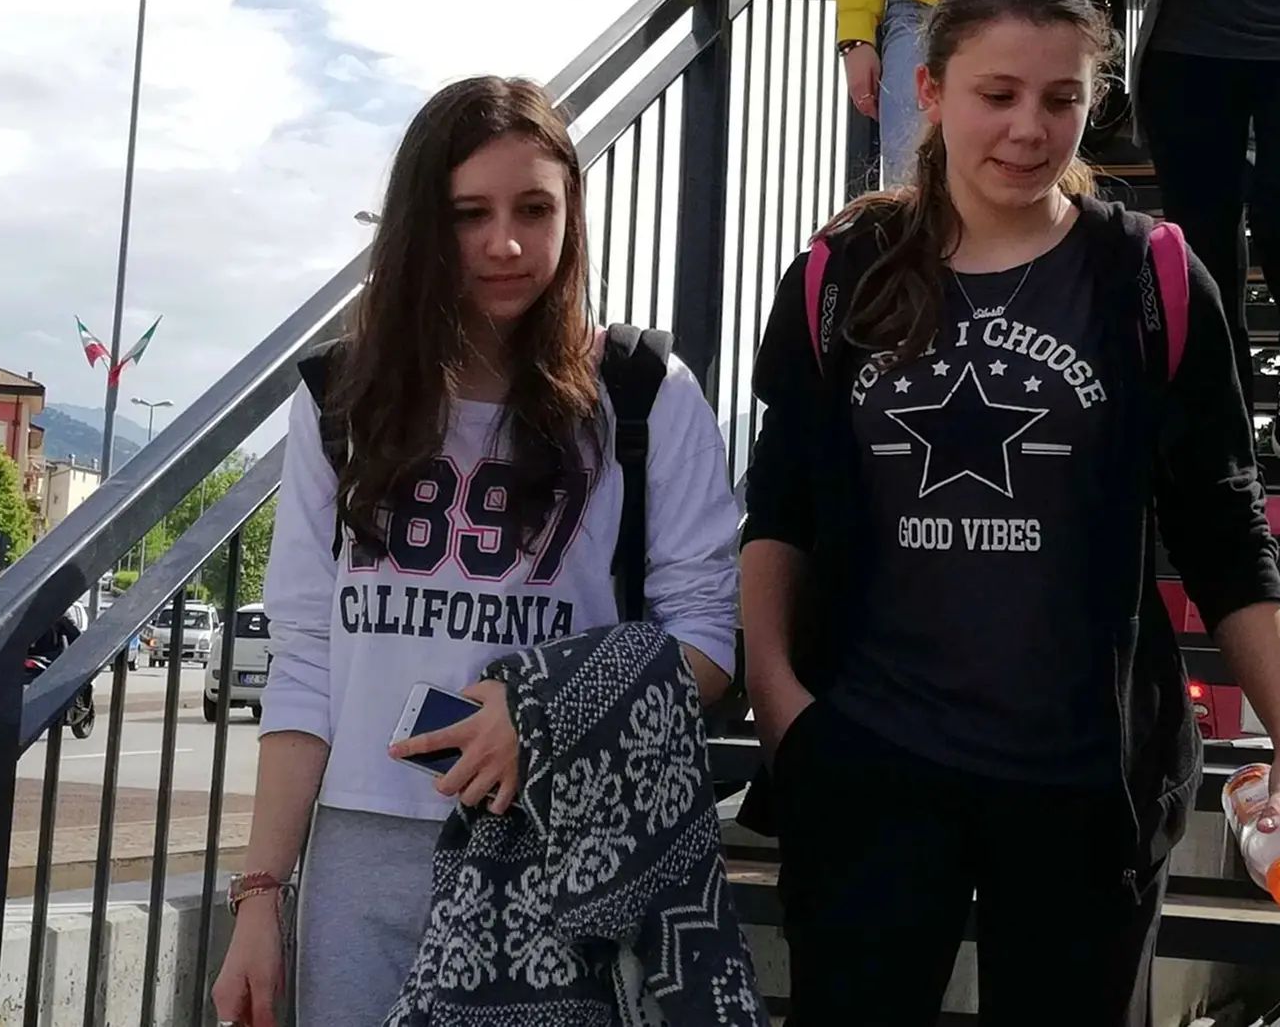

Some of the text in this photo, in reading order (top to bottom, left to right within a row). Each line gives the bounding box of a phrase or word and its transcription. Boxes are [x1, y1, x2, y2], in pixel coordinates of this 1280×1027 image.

[955, 321, 970, 347] I
[982, 317, 1108, 409] CHOOSE
[899, 515, 1041, 551] GOOD VIBES
